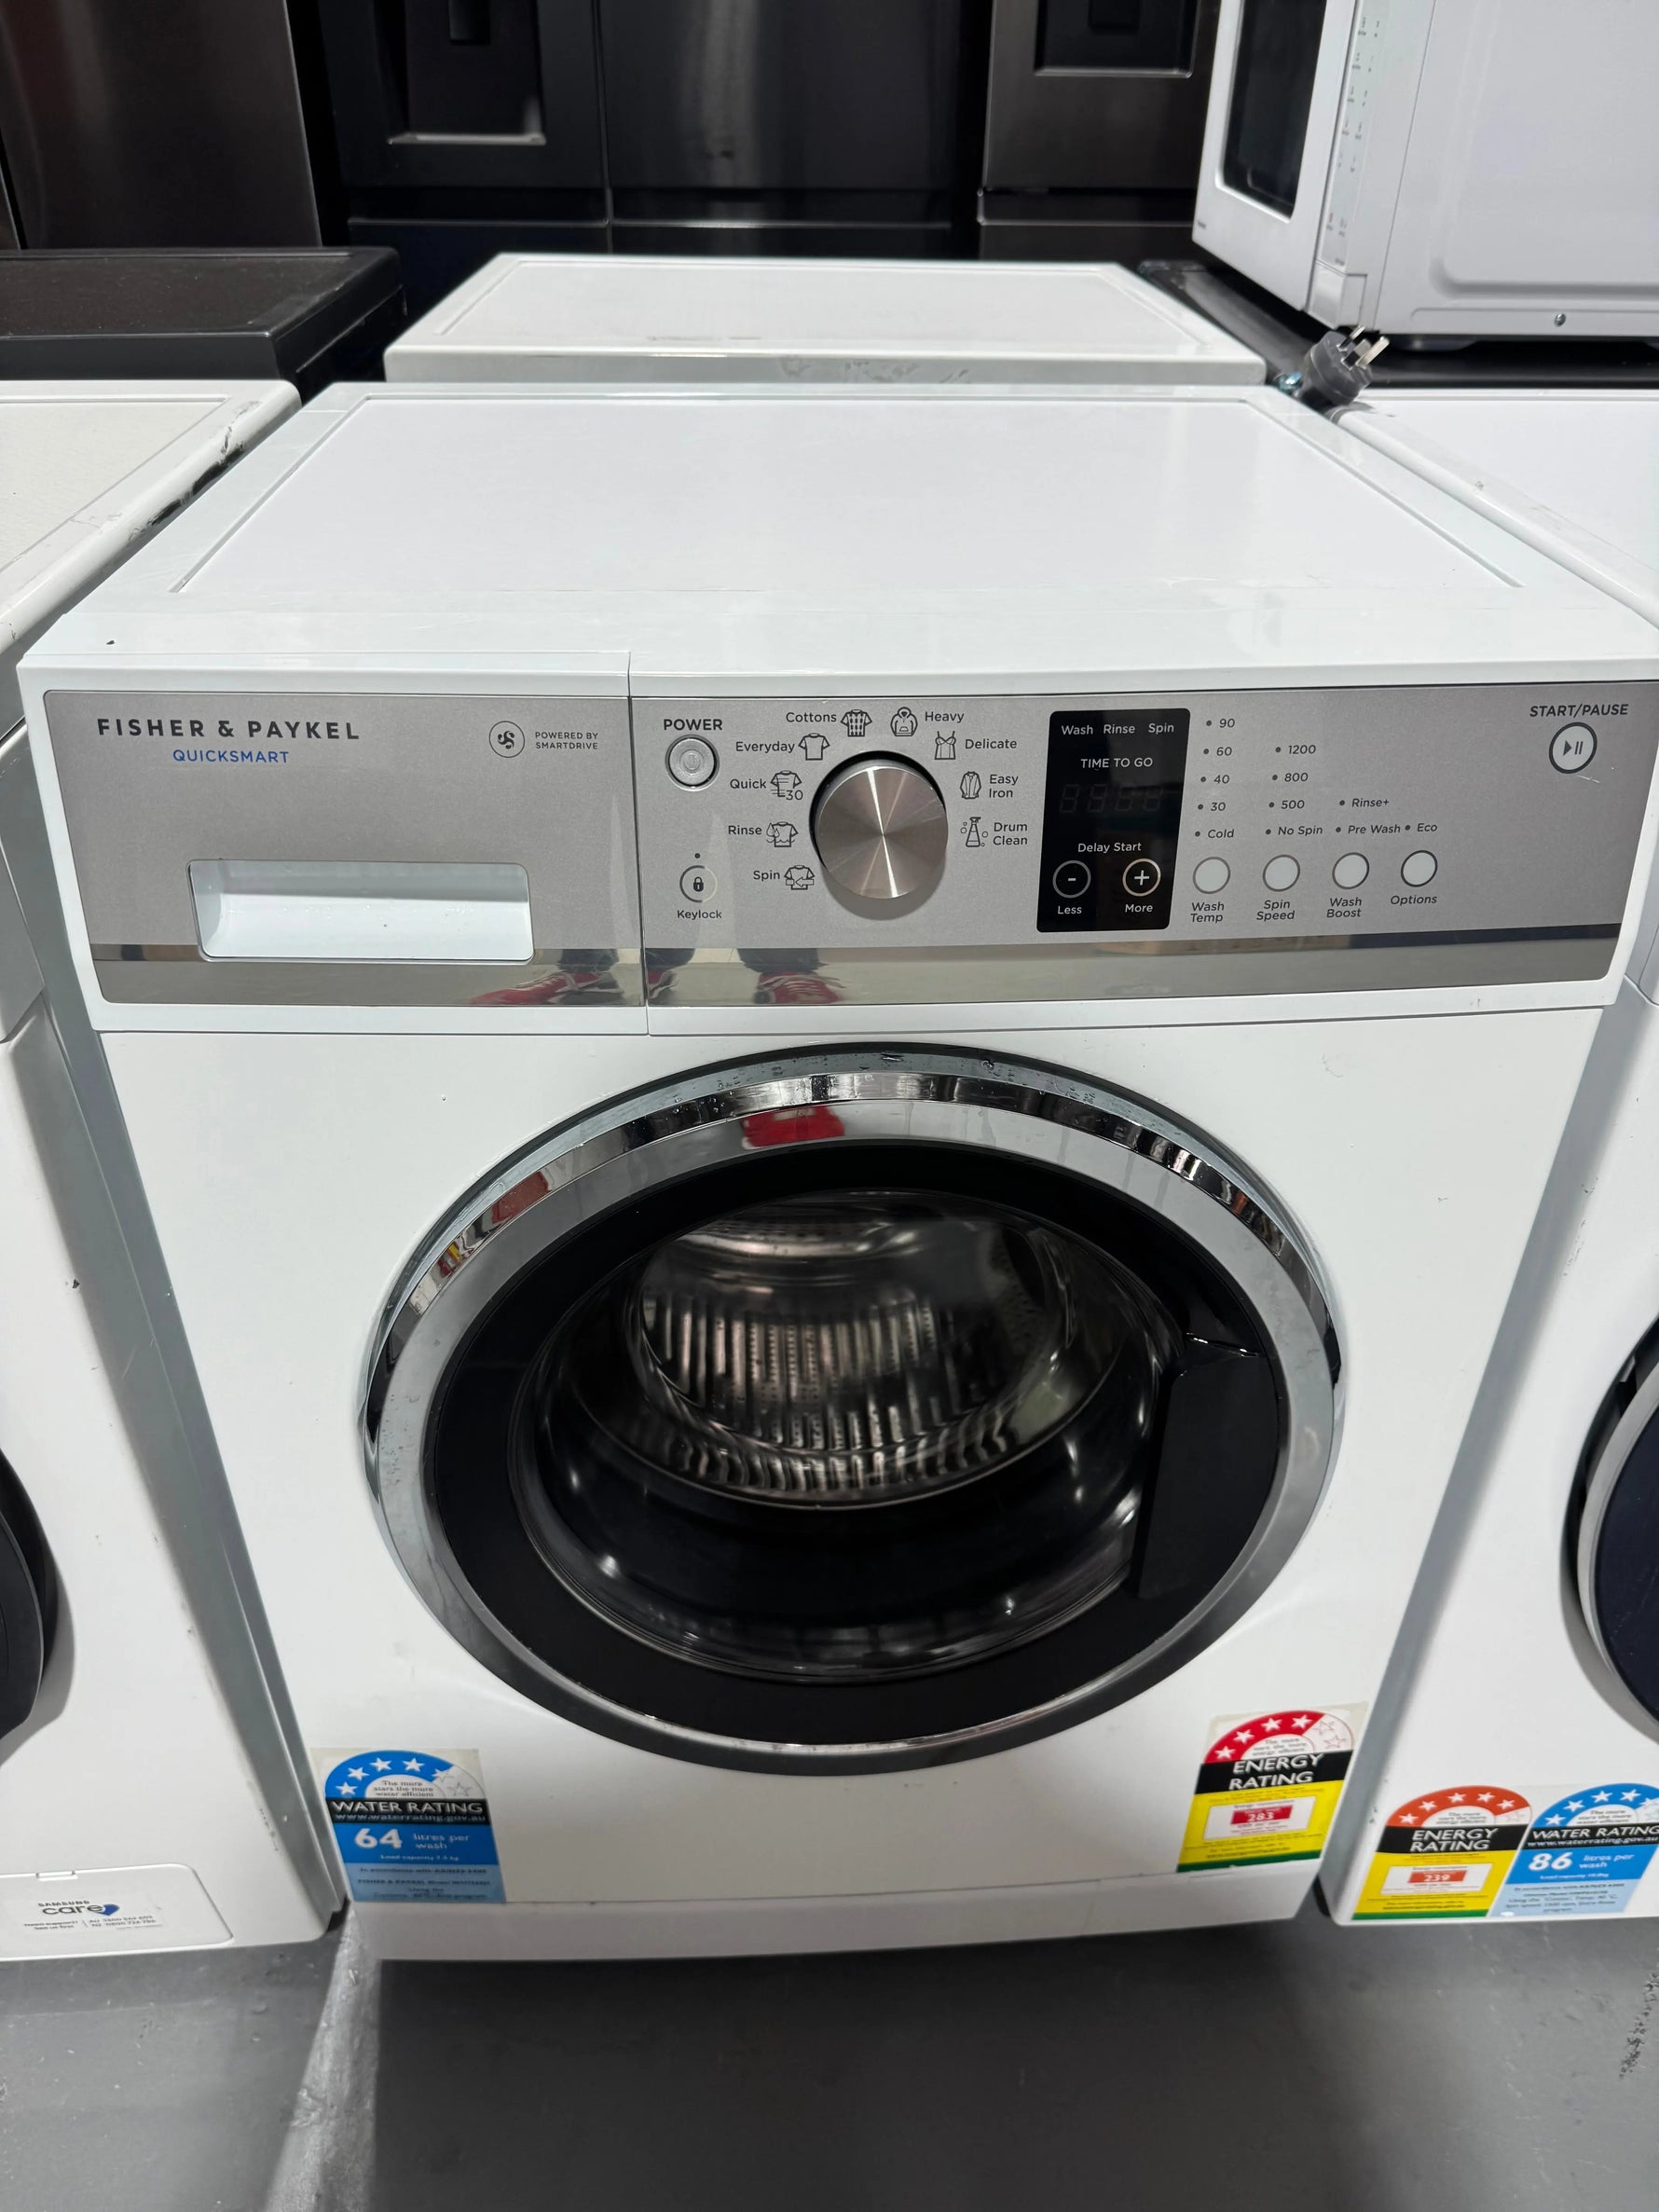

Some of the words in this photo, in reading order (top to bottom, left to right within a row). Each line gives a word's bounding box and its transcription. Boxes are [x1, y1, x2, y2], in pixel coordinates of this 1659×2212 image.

[1529, 703, 1629, 718] START/PAUSE
[786, 711, 837, 723] Cottons
[925, 711, 965, 723] Heavy
[97, 718, 204, 738] FISHER
[218, 720, 235, 738] &
[249, 721, 360, 740] PAYKEL
[664, 719, 722, 731] POWER
[1104, 723, 1136, 735] Rinse
[1148, 722, 1174, 735] Spin
[1219, 719, 1236, 728] 90
[1061, 725, 1093, 735] Wash
[535, 732, 582, 741] POWERED
[585, 732, 599, 741] BY
[535, 741, 598, 750] SMARTDRIVE
[735, 741, 795, 754] Everyday
[965, 738, 1018, 749] Delicate
[1216, 747, 1233, 757] 60
[1288, 745, 1316, 755] 1200
[172, 749, 290, 764] QUICKSMART
[1080, 758, 1110, 768] TIME
[1114, 758, 1131, 768] TO
[1134, 757, 1153, 767] GO
[990, 774, 1019, 786] Easy
[1213, 775, 1230, 784] 40
[1284, 772, 1309, 782] 800
[730, 778, 767, 790] Quick
[786, 790, 803, 801] 30
[989, 788, 1013, 799] Iron
[1211, 802, 1227, 812] 30
[1281, 800, 1305, 809] 500
[1351, 798, 1390, 808] Rinse+
[728, 824, 762, 835] Rinse
[994, 821, 1028, 832] Drum
[1278, 826, 1295, 835] No
[1297, 825, 1323, 837] Spin
[1348, 824, 1366, 834] Pre
[1370, 823, 1401, 834] Wash
[1417, 822, 1438, 832] Eco
[1208, 829, 1235, 839] Cold
[993, 835, 1028, 845] Clean
[1077, 843, 1110, 854] Delay
[1114, 842, 1142, 852] Start
[753, 870, 781, 883] Spin
[1264, 900, 1290, 911] Spin
[1330, 897, 1362, 907] Wash
[1390, 895, 1437, 906] Options
[1058, 905, 1082, 914] Less
[1125, 904, 1154, 913] More
[1192, 901, 1225, 912] Wash
[677, 908, 722, 921] Keylock
[1190, 913, 1224, 924] Temp
[1256, 910, 1296, 921] Speed
[1326, 908, 1362, 918] Boost
[1233, 1753, 1323, 1774] ENERGY
[1229, 1772, 1314, 1790] RATING
[332, 1801, 402, 1813] WATER
[408, 1802, 484, 1814] RATING
[336, 1814, 486, 1822] www.waterrating.gov.au
[1412, 1828, 1499, 1841] ENERGY
[1532, 1828, 1590, 1840] WATER
[1596, 1825, 1659, 1837] RATING
[354, 1828, 403, 1849] 64
[449, 1834, 470, 1843] per
[1528, 1836, 1658, 1847] www.waterrating.gov.au
[1410, 1840, 1490, 1852] RATING
[1529, 1851, 1573, 1871] 86
[1584, 1854, 1611, 1862] litres
[1613, 1854, 1635, 1862] per
[42, 1904, 103, 1916] care
